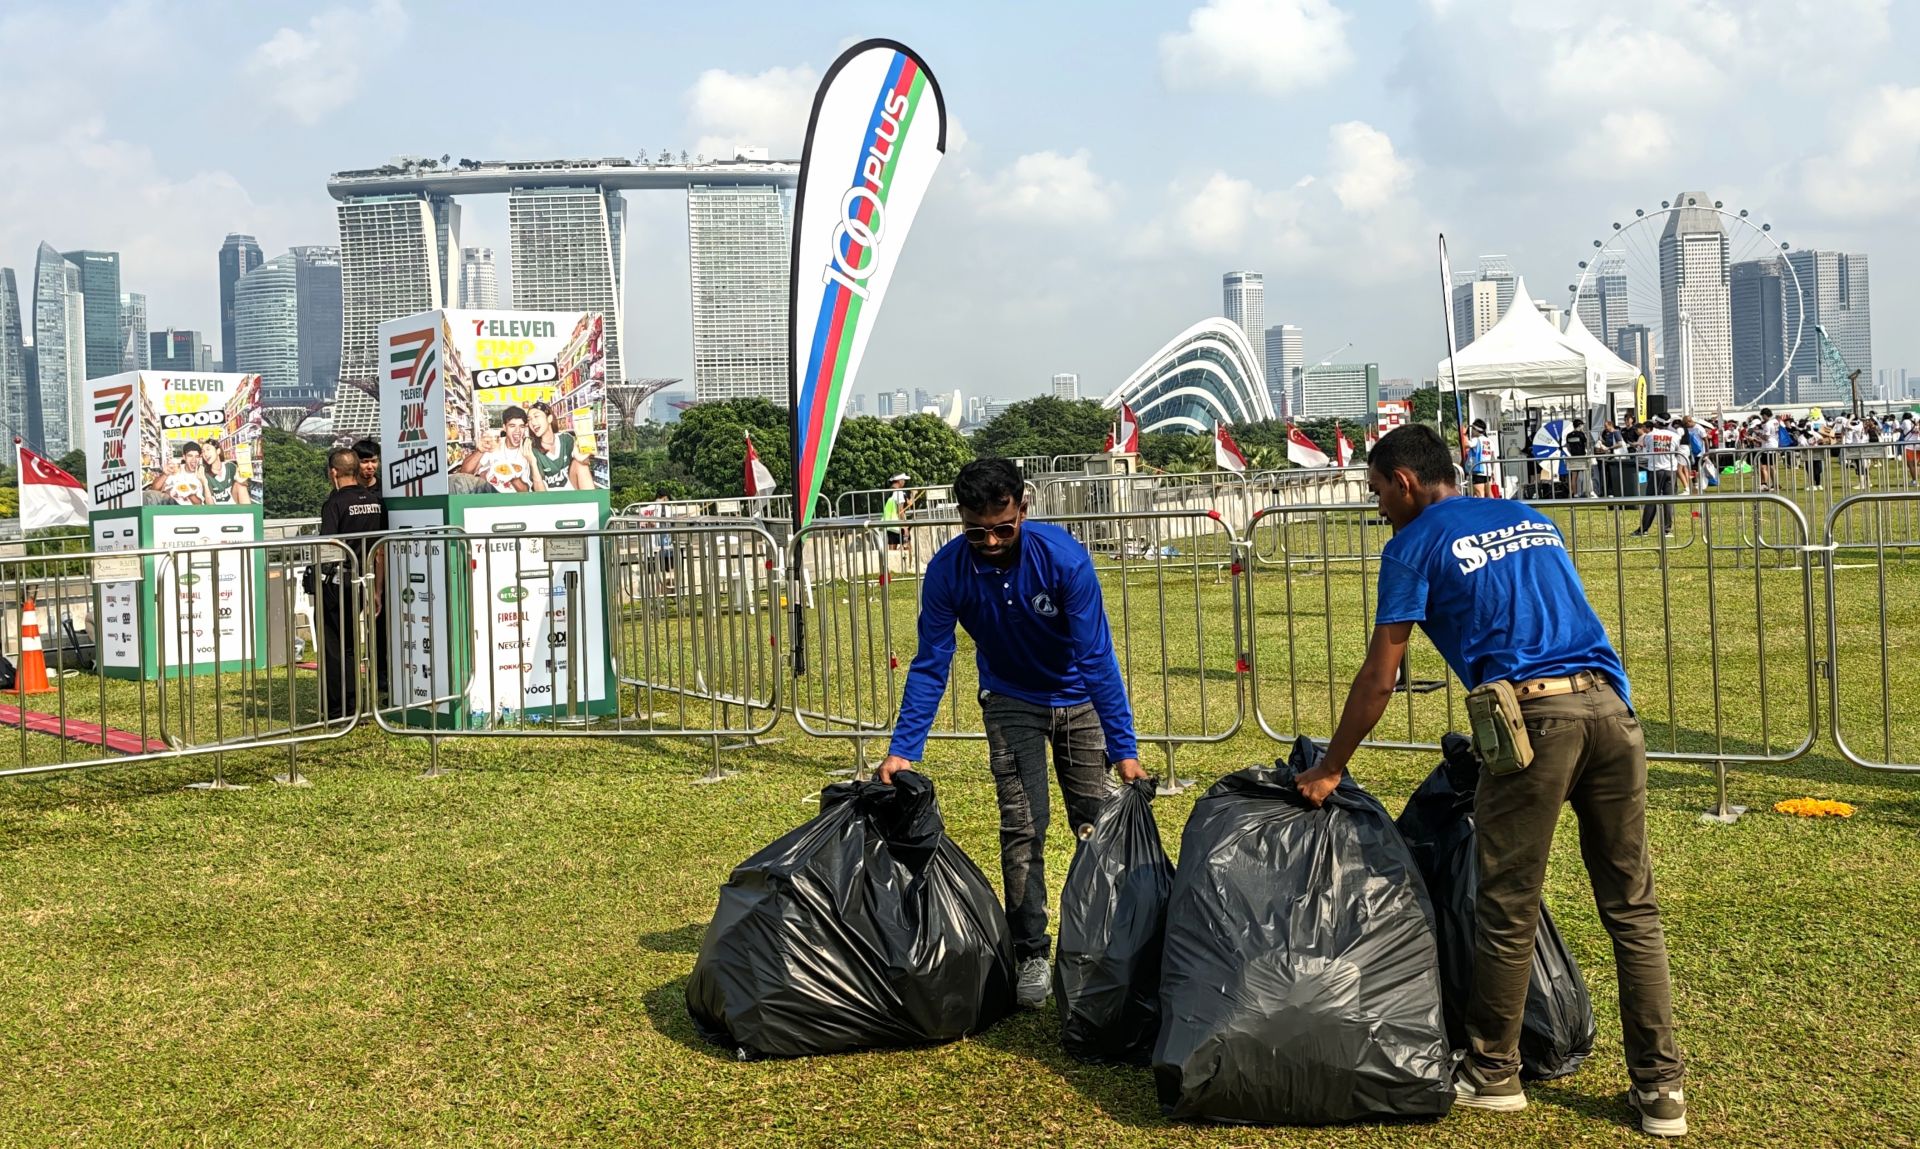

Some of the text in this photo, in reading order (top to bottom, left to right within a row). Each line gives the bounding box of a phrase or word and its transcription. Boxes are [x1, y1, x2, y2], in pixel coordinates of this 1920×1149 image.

[476, 363, 557, 389] GOOD
[164, 411, 224, 428] GOOD
[400, 402, 425, 430] RUN
[103, 438, 123, 460] RUN
[392, 450, 436, 485] FINISH
[96, 473, 134, 501] FINISH
[349, 503, 381, 516] SECURITY
[475, 541, 521, 553] 7-LEVE
[498, 611, 530, 623] FIREBLL
[524, 683, 554, 694] VÖOS
